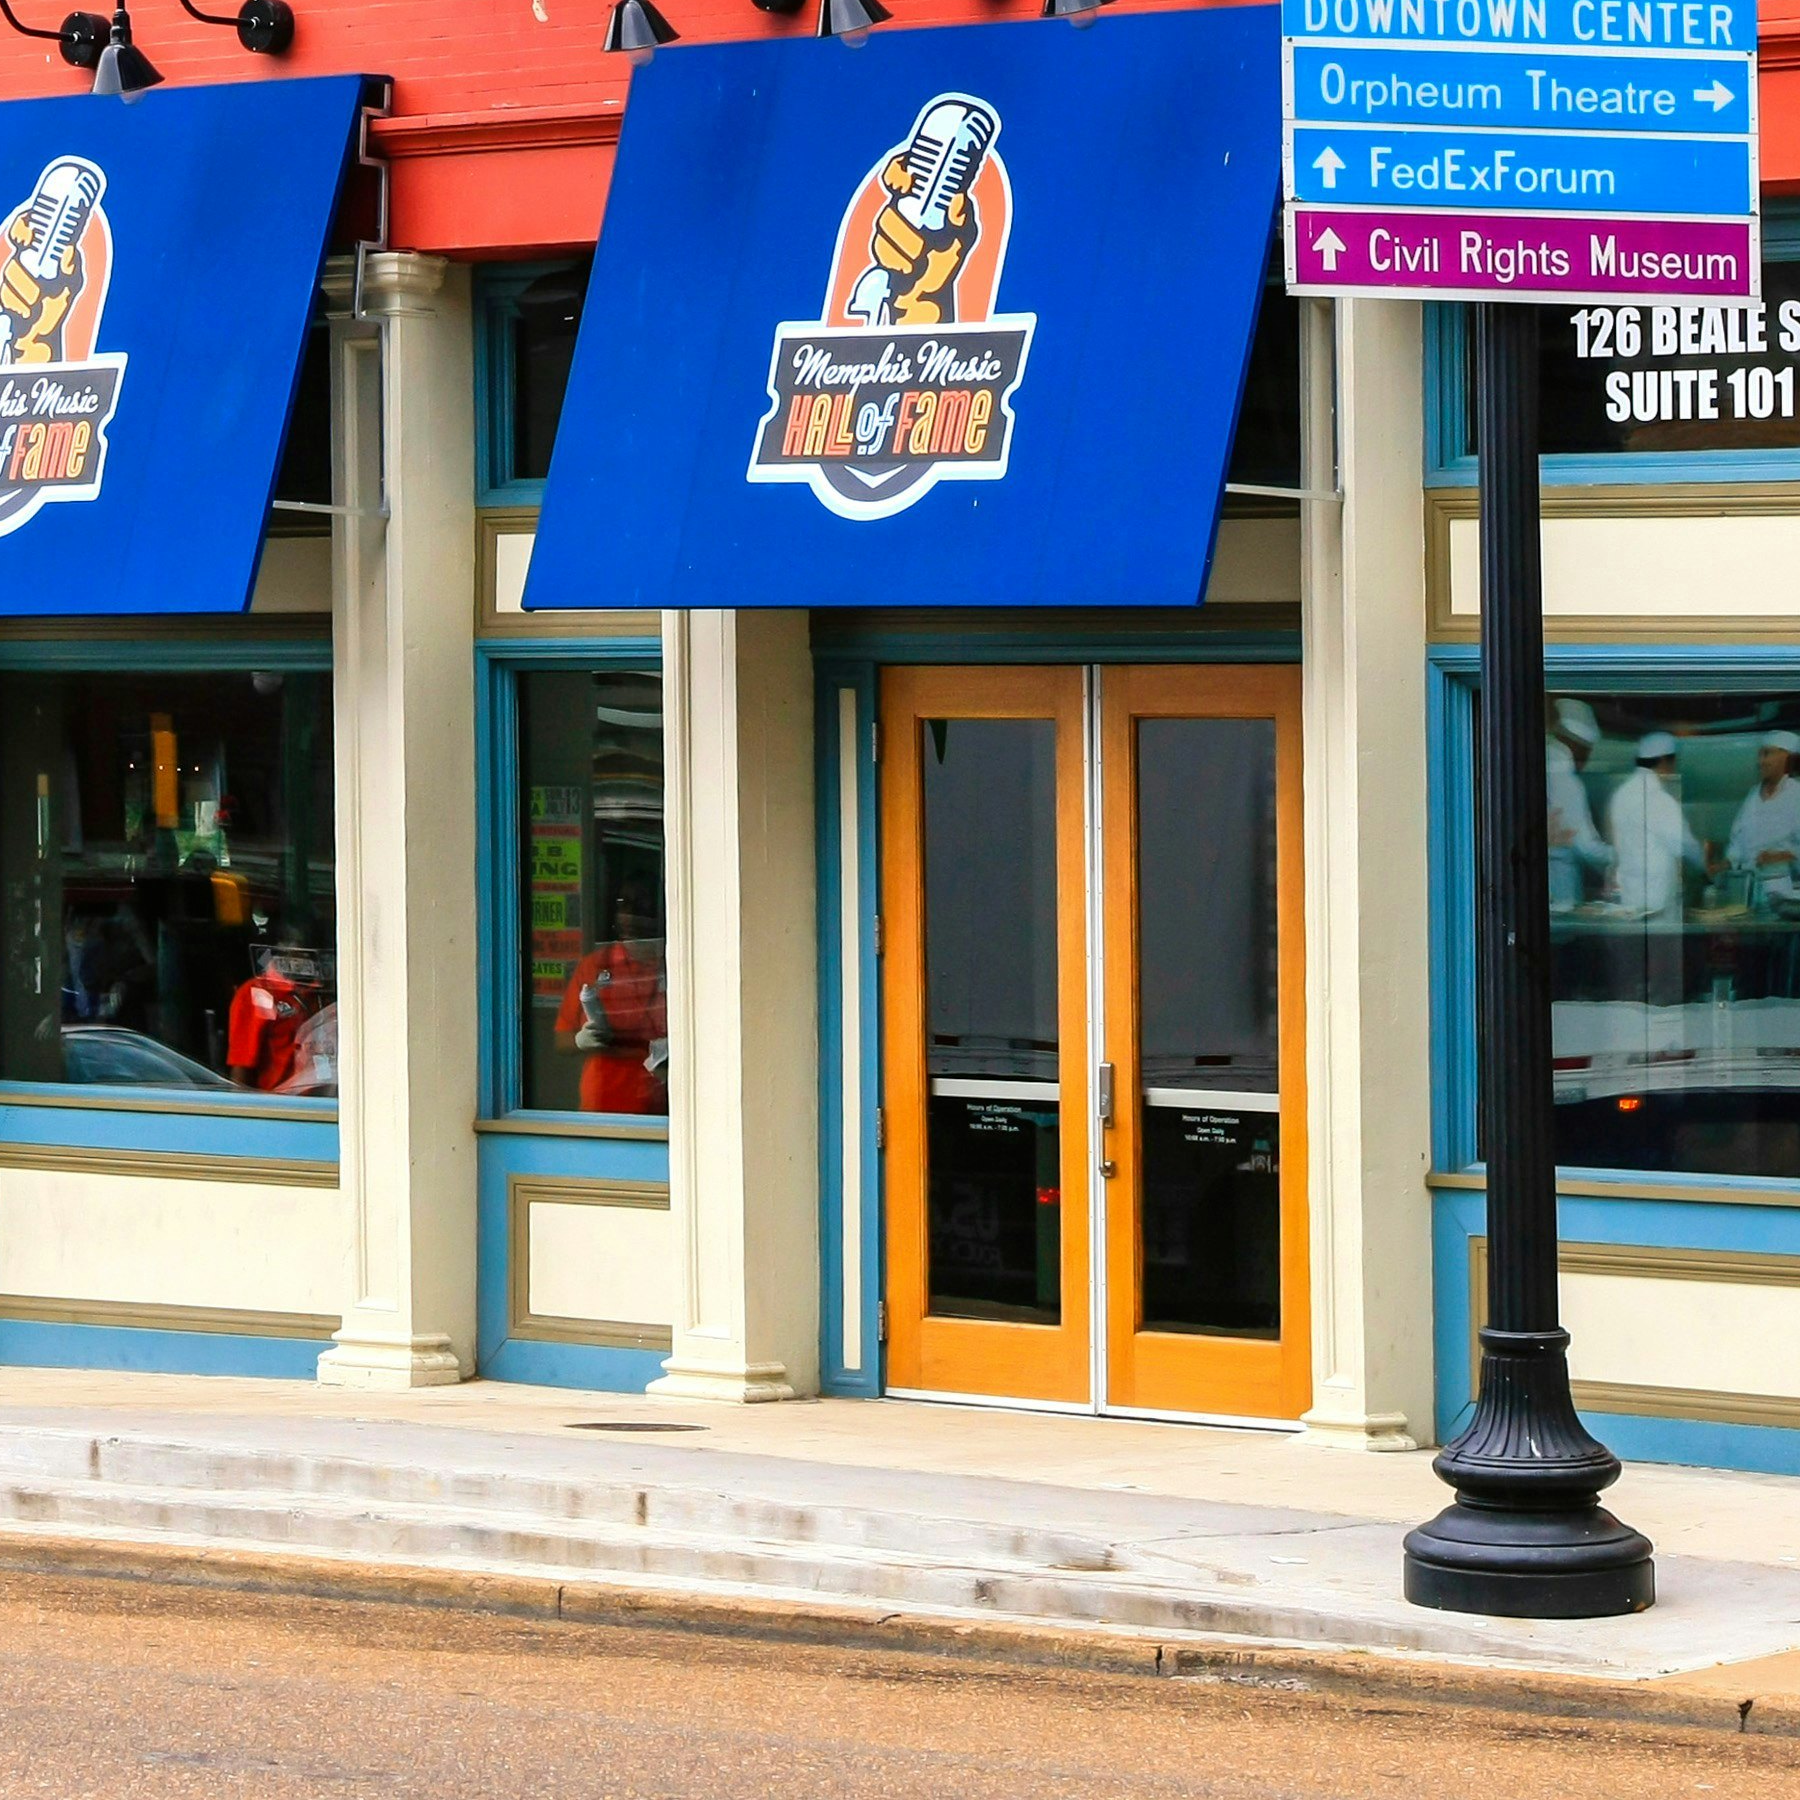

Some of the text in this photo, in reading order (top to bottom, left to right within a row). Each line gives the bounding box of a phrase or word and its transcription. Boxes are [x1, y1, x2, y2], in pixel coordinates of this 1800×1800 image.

[1572, 0, 1733, 46] CENTER
[1320, 63, 1676, 116] Orpheum Theatre
[1369, 147, 1615, 196] FedExForum
[1368, 228, 1738, 284] Civil Rights Museum
[1570, 307, 1642, 358] 126
[1652, 303, 1767, 356] BEALE
[792, 340, 1002, 398] Memphis Music
[1605, 366, 1794, 423] SUITE 101
[30, 377, 99, 419] Music
[782, 393, 854, 456] HALL
[855, 391, 900, 456] of
